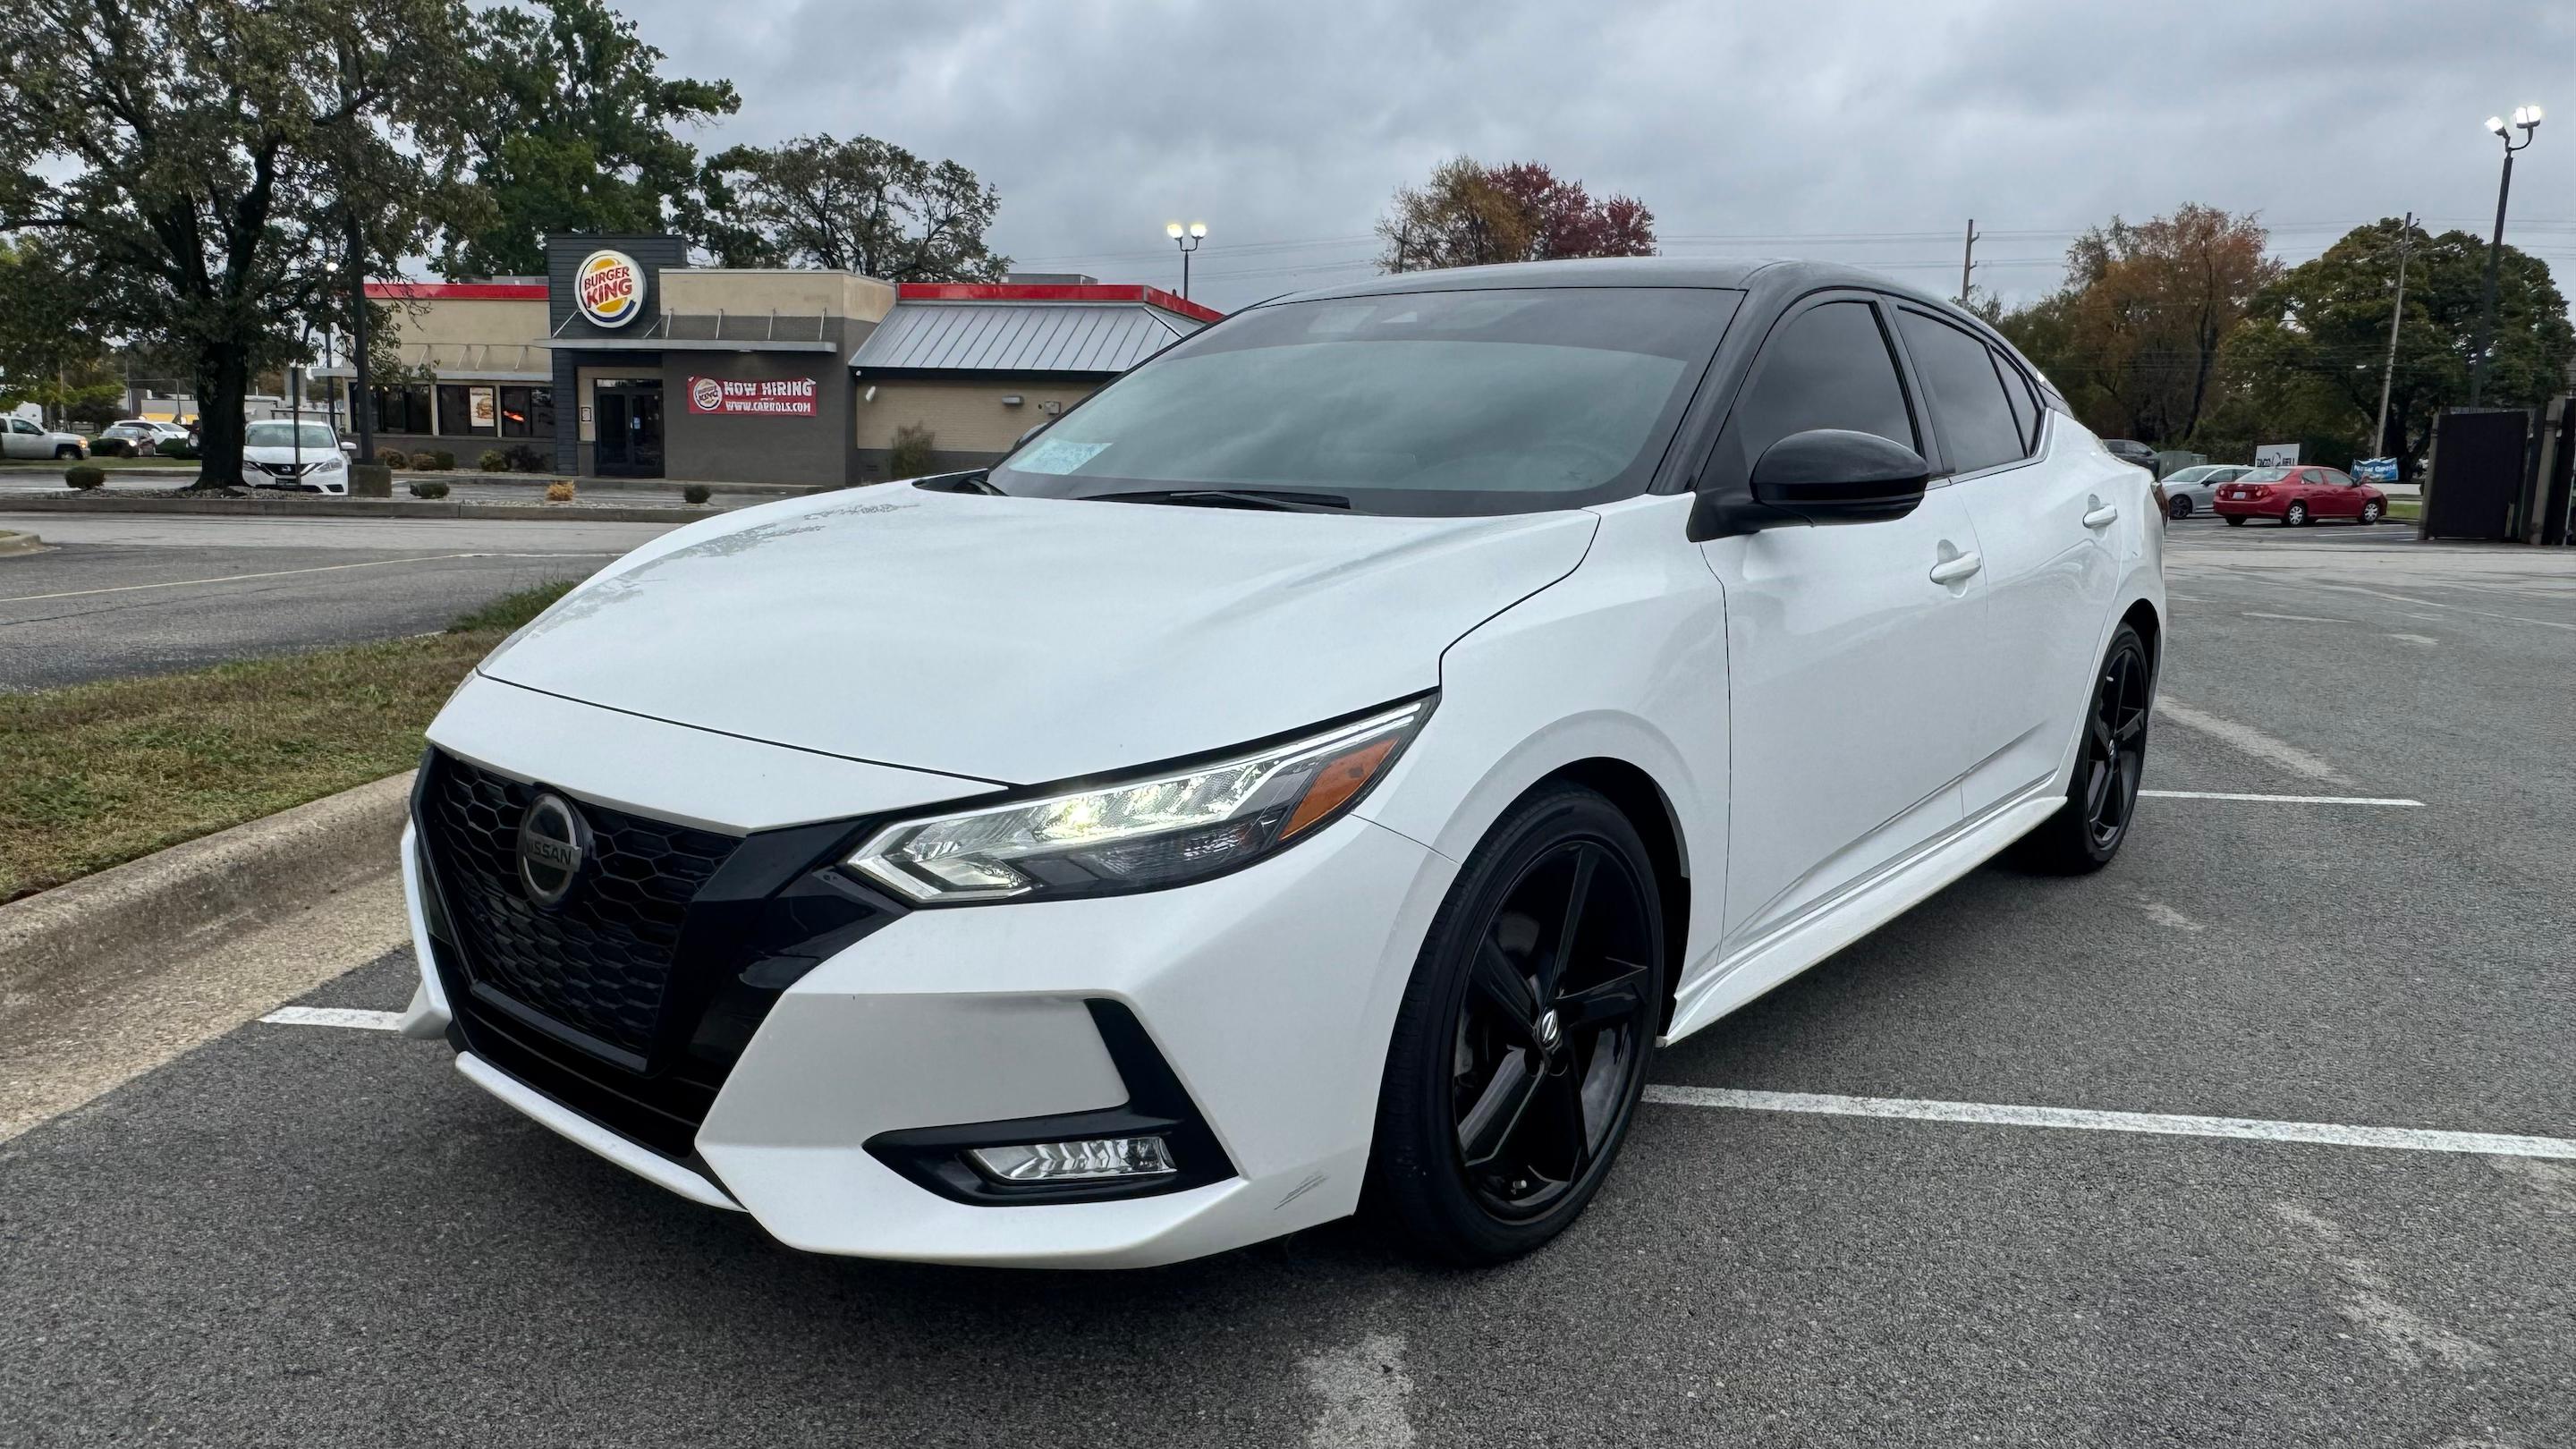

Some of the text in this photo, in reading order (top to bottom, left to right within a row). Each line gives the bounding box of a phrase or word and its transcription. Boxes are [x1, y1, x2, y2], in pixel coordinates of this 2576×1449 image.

[584, 267, 630, 291] BURGER
[587, 278, 632, 309] KING
[724, 381, 757, 396] NOW
[761, 381, 812, 396] HIRING
[725, 401, 811, 412] WWW.CARROLS.COM
